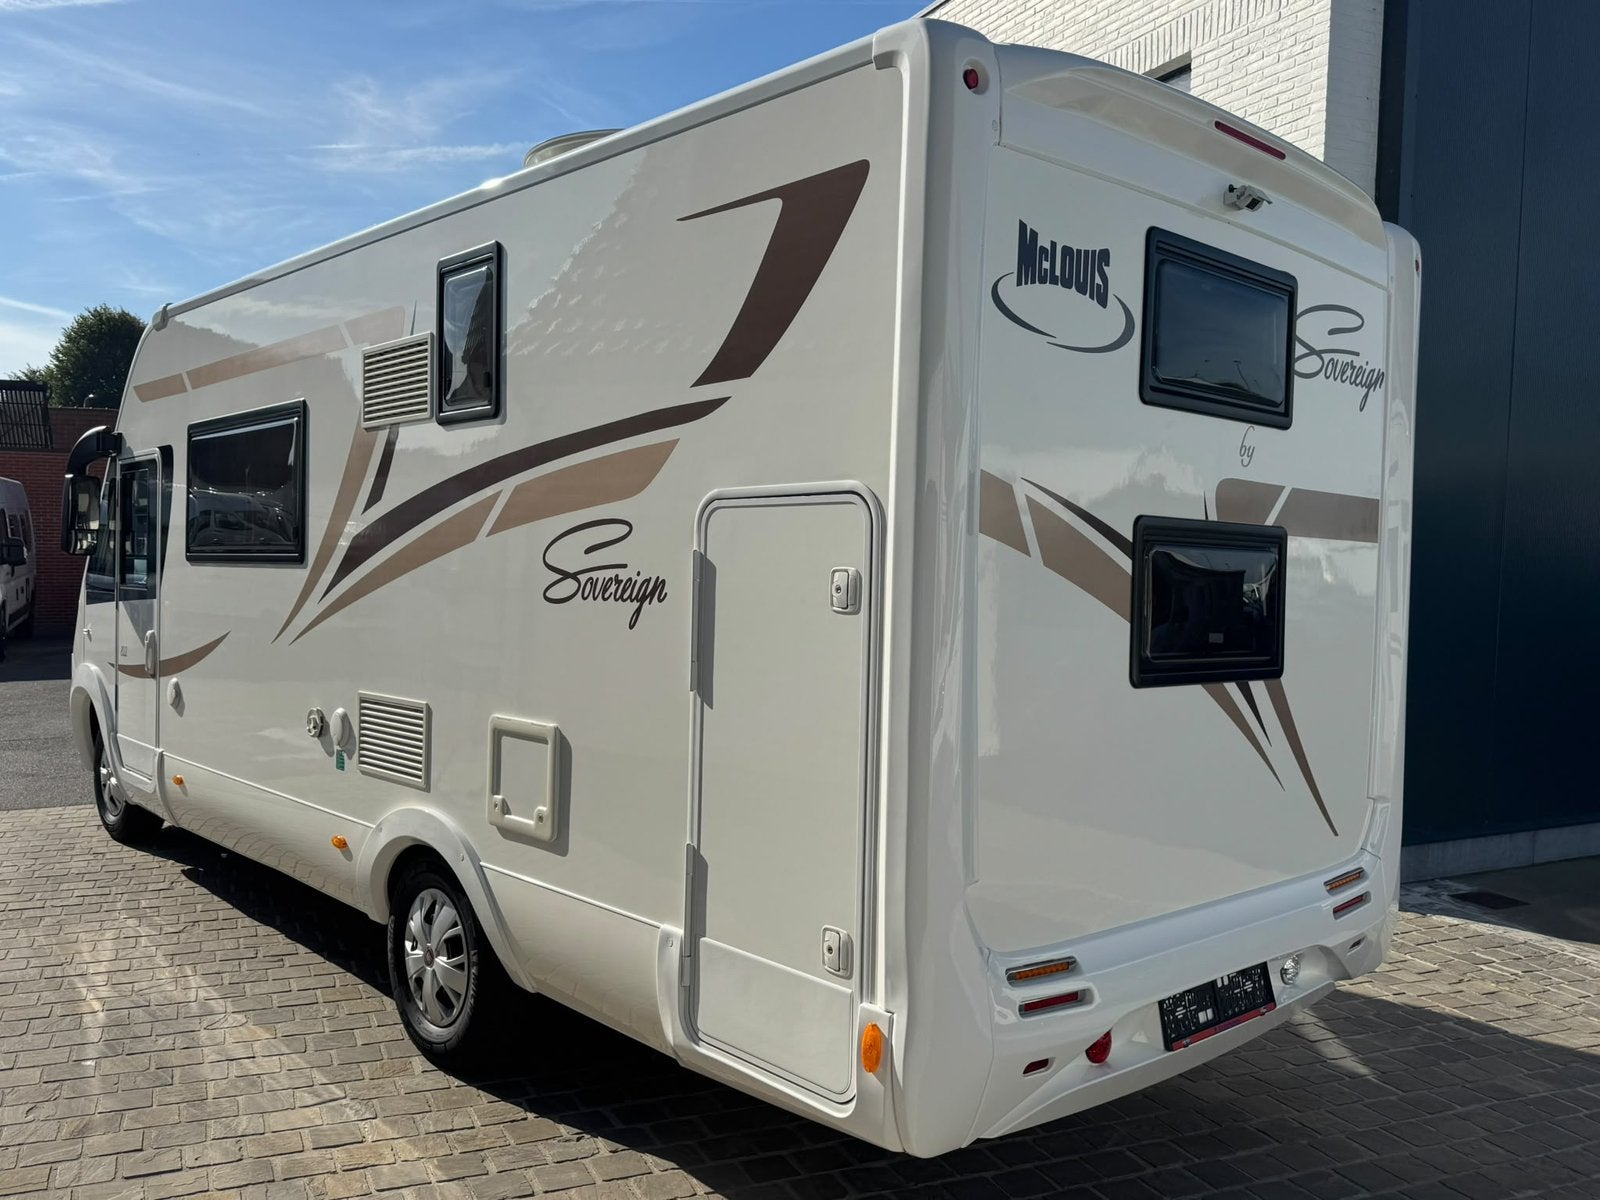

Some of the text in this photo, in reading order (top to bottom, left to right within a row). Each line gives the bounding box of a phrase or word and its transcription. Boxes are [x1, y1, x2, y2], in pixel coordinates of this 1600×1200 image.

[1293, 303, 1386, 412] Sovereign
[1239, 425, 1256, 468] by
[542, 517, 668, 631] Sovereign
